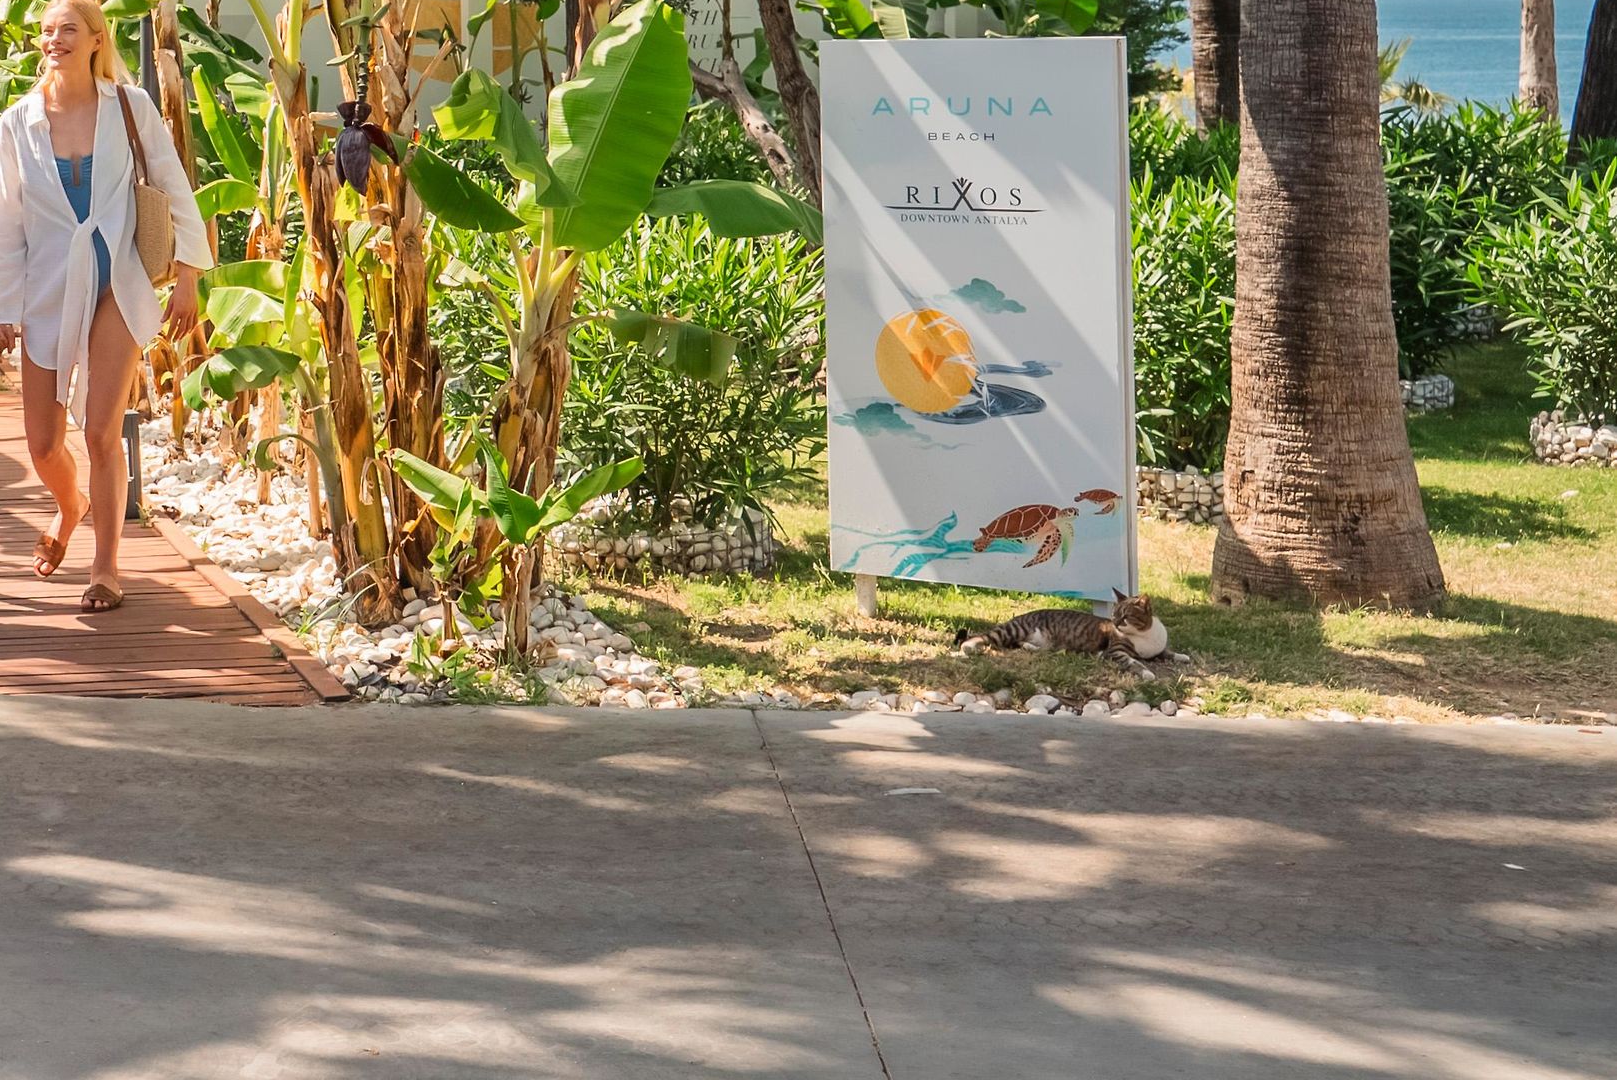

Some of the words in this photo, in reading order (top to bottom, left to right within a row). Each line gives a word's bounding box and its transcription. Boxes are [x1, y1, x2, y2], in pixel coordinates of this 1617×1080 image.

[871, 96, 1053, 116] ARUNA
[928, 132, 995, 141] BEACH
[905, 177, 1023, 210] RIXOS
[900, 213, 970, 223] DOWNTOWN
[975, 216, 1028, 225] ANTALYA
